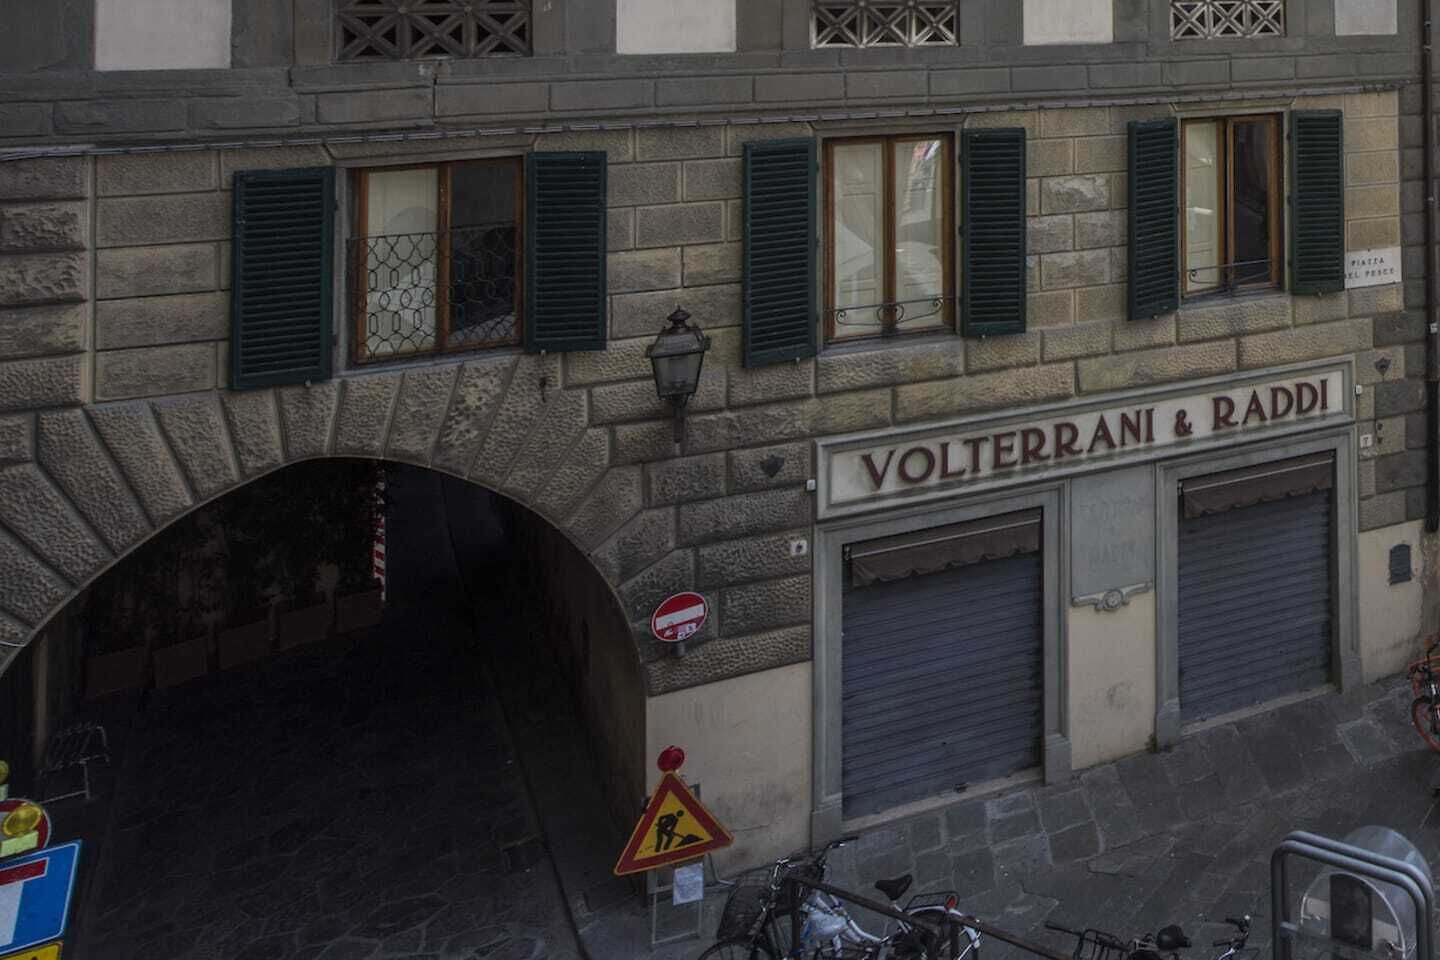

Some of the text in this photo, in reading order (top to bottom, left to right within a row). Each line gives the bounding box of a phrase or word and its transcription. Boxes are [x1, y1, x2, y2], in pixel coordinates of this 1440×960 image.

[861, 378, 1329, 489] VOLTERRANI & RADDI
